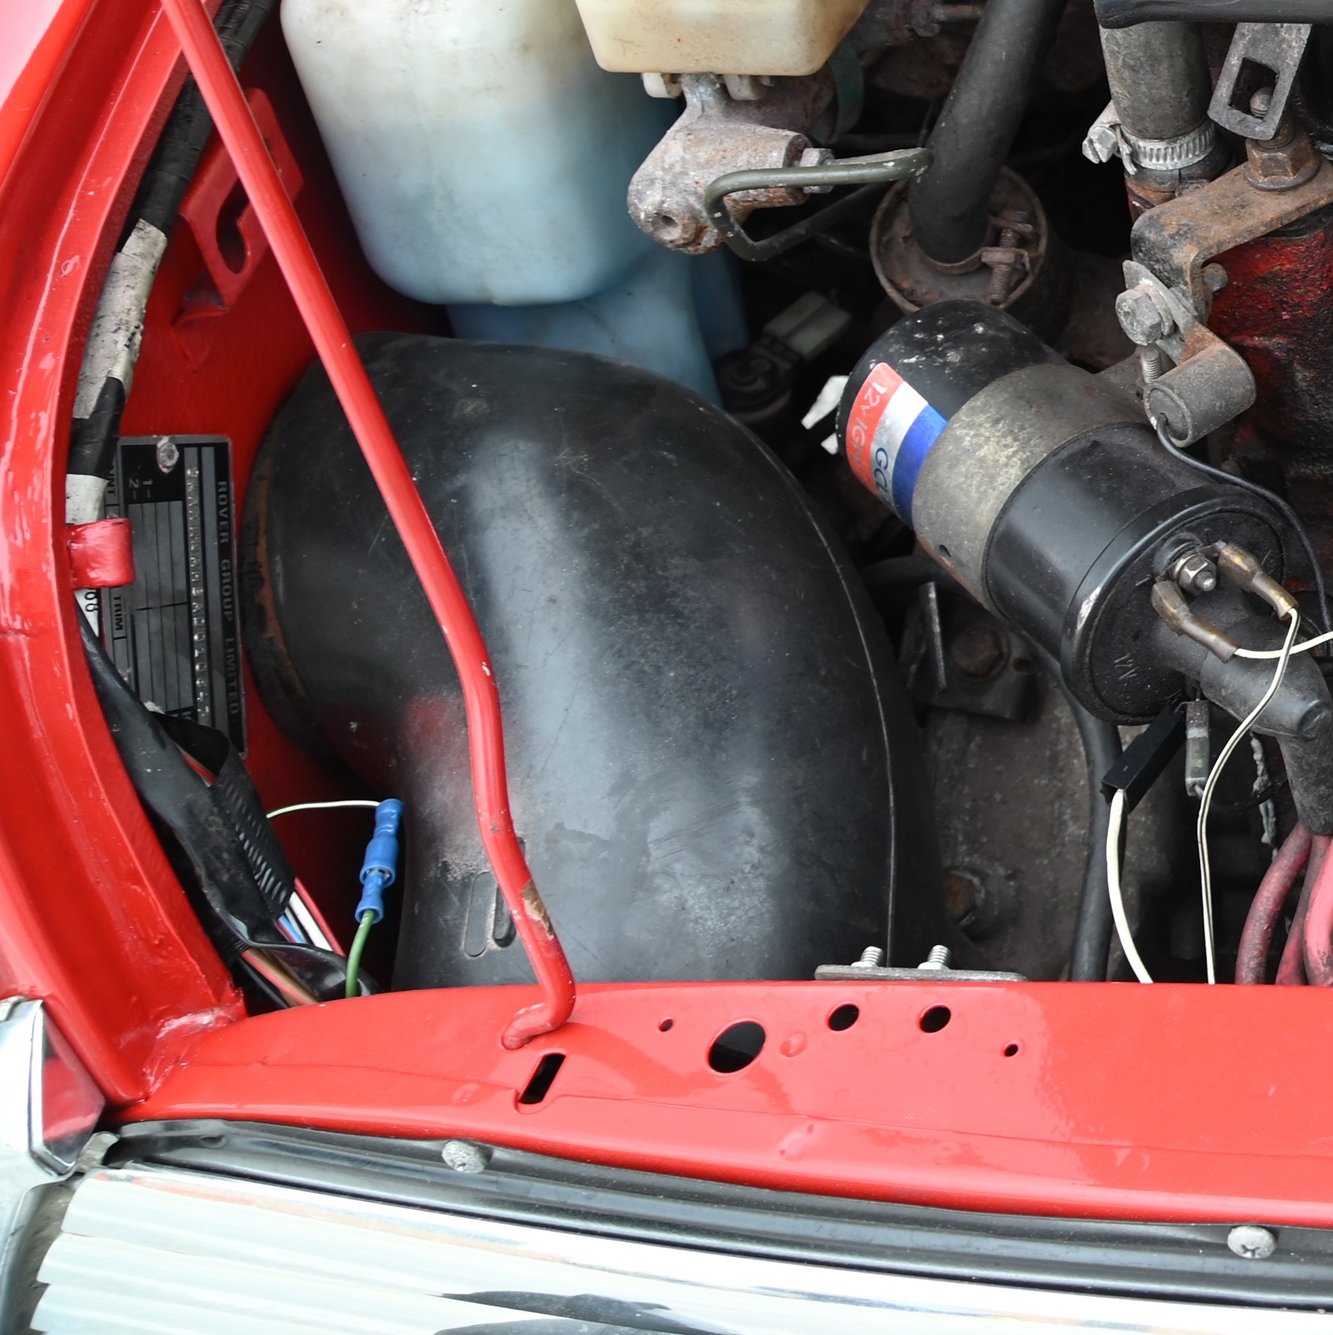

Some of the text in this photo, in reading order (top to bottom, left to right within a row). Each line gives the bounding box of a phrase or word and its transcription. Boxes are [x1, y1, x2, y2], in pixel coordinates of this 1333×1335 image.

[113, 595, 124, 632] TRIM
[217, 480, 240, 716] ROVER GROUP LIMITED
